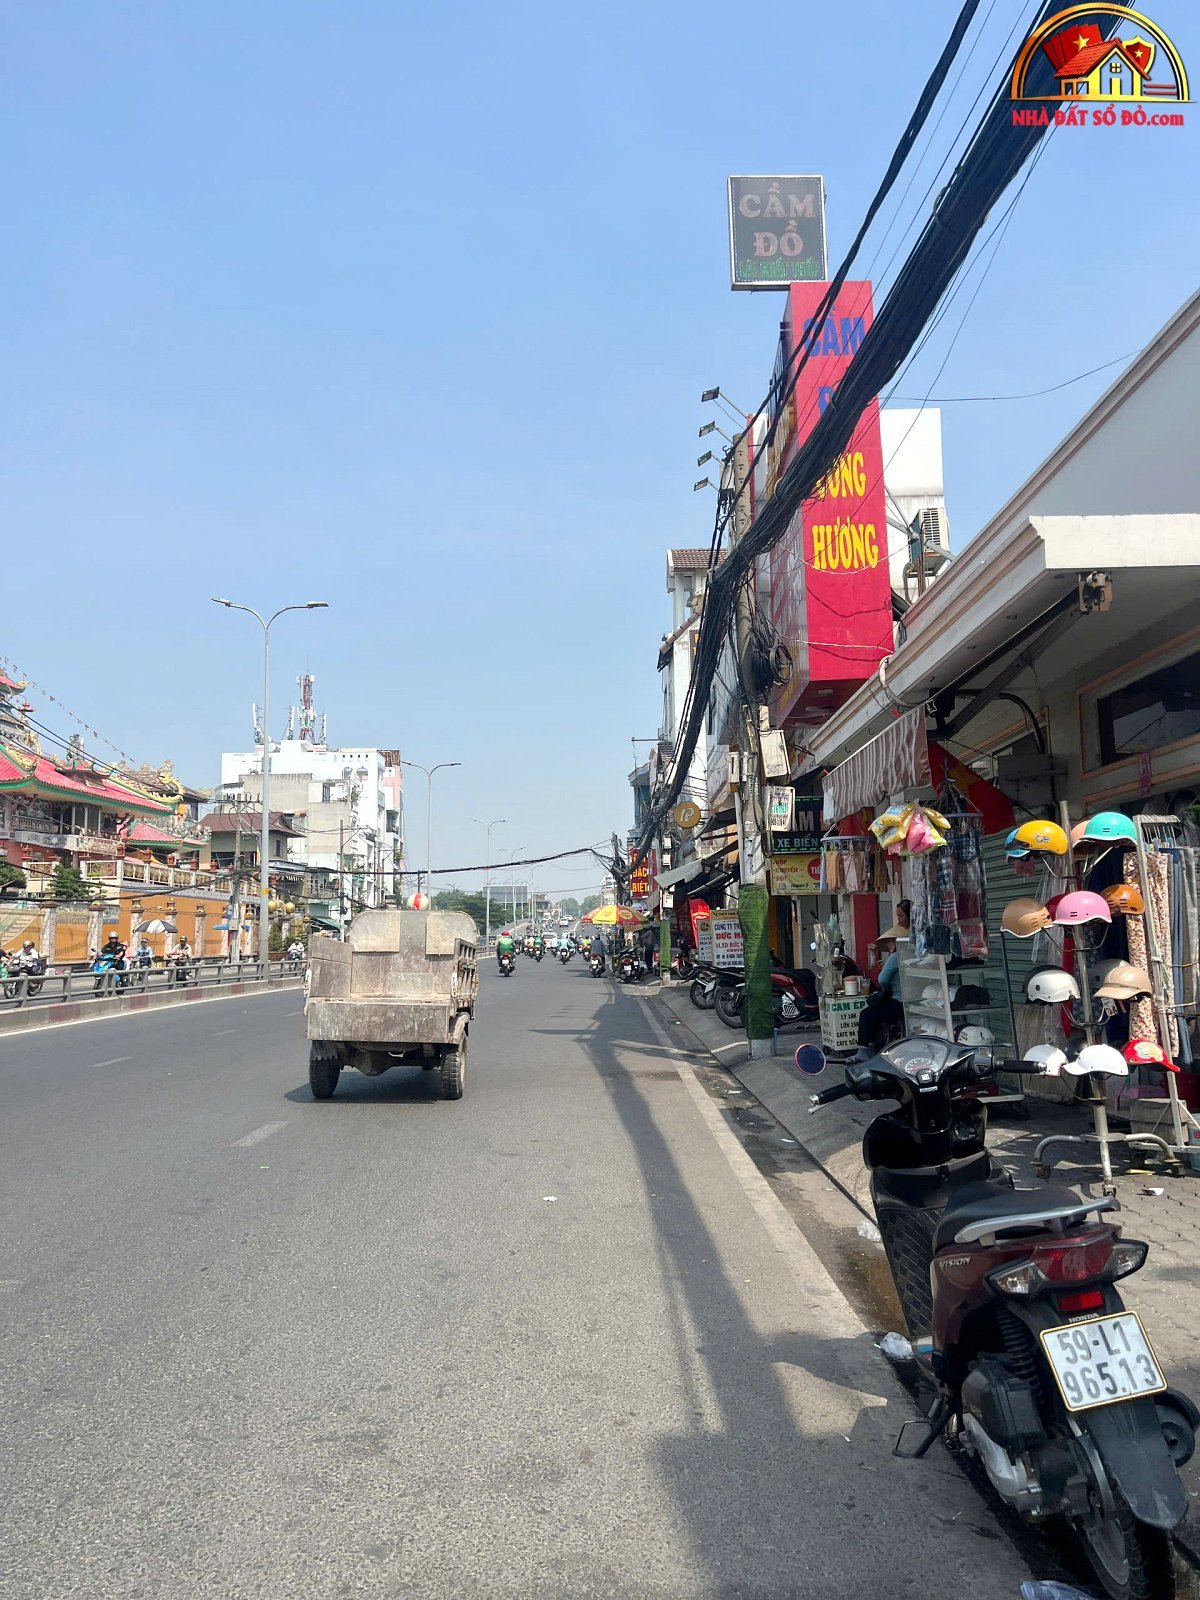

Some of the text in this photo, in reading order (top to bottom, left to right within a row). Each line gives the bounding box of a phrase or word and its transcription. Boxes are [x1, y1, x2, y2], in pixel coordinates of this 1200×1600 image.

[739, 182, 816, 218] CẦM
[753, 219, 804, 257] ĐỒ
[777, 838, 790, 848] XE
[632, 880, 648, 894] BIỆT
[832, 1002, 850, 1011] CAM
[939, 1256, 971, 1267] VISION
[1068, 1312, 1099, 1323] HONDA
[1056, 1319, 1133, 1365] 59-L1
[1062, 1353, 1158, 1404] 965.13
